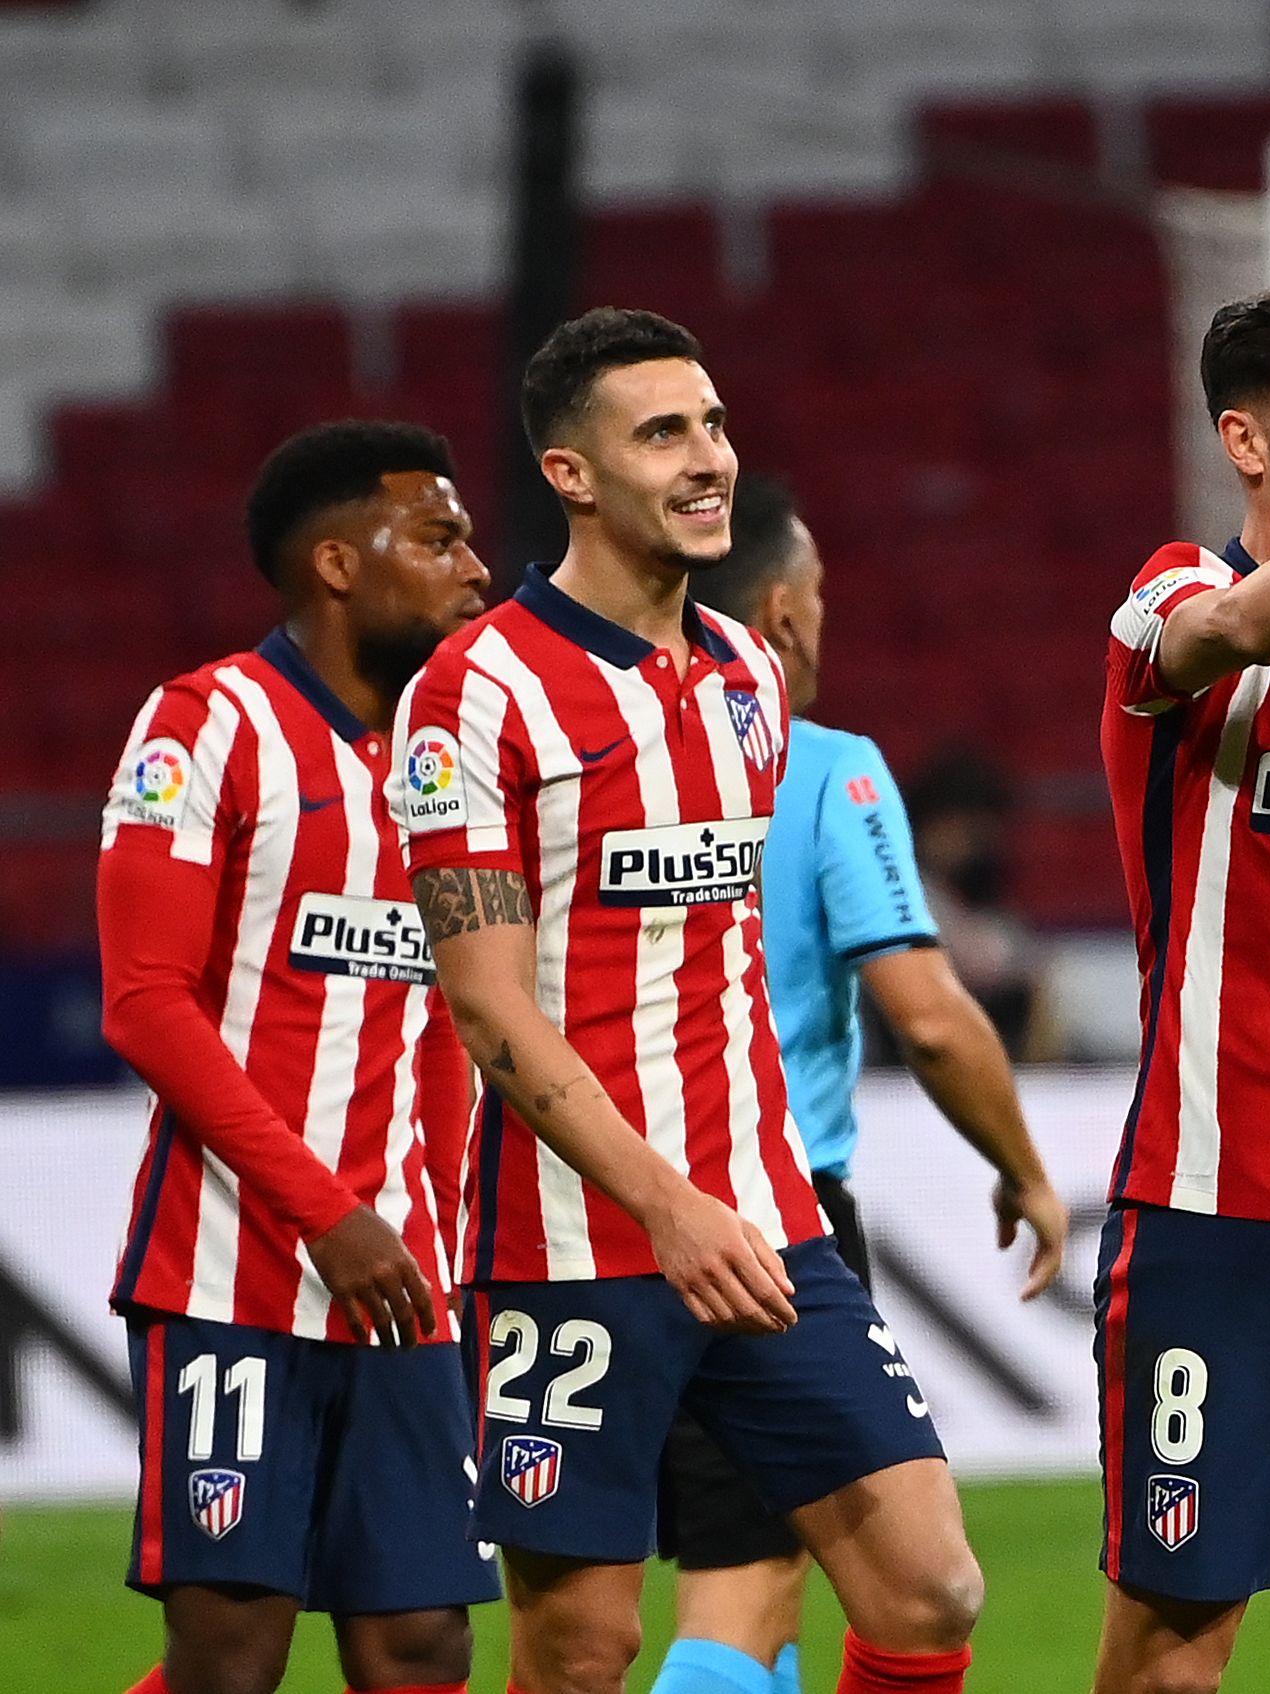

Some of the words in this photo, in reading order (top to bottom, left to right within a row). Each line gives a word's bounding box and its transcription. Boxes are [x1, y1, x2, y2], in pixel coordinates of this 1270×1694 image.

[411, 797, 460, 818] LaLiga
[671, 887, 712, 904] Trade
[300, 912, 433, 962] Plus5
[348, 960, 387, 979] Trade
[484, 1309, 612, 1432] 22
[178, 1353, 267, 1461] 11
[1151, 1347, 1208, 1466] 8
